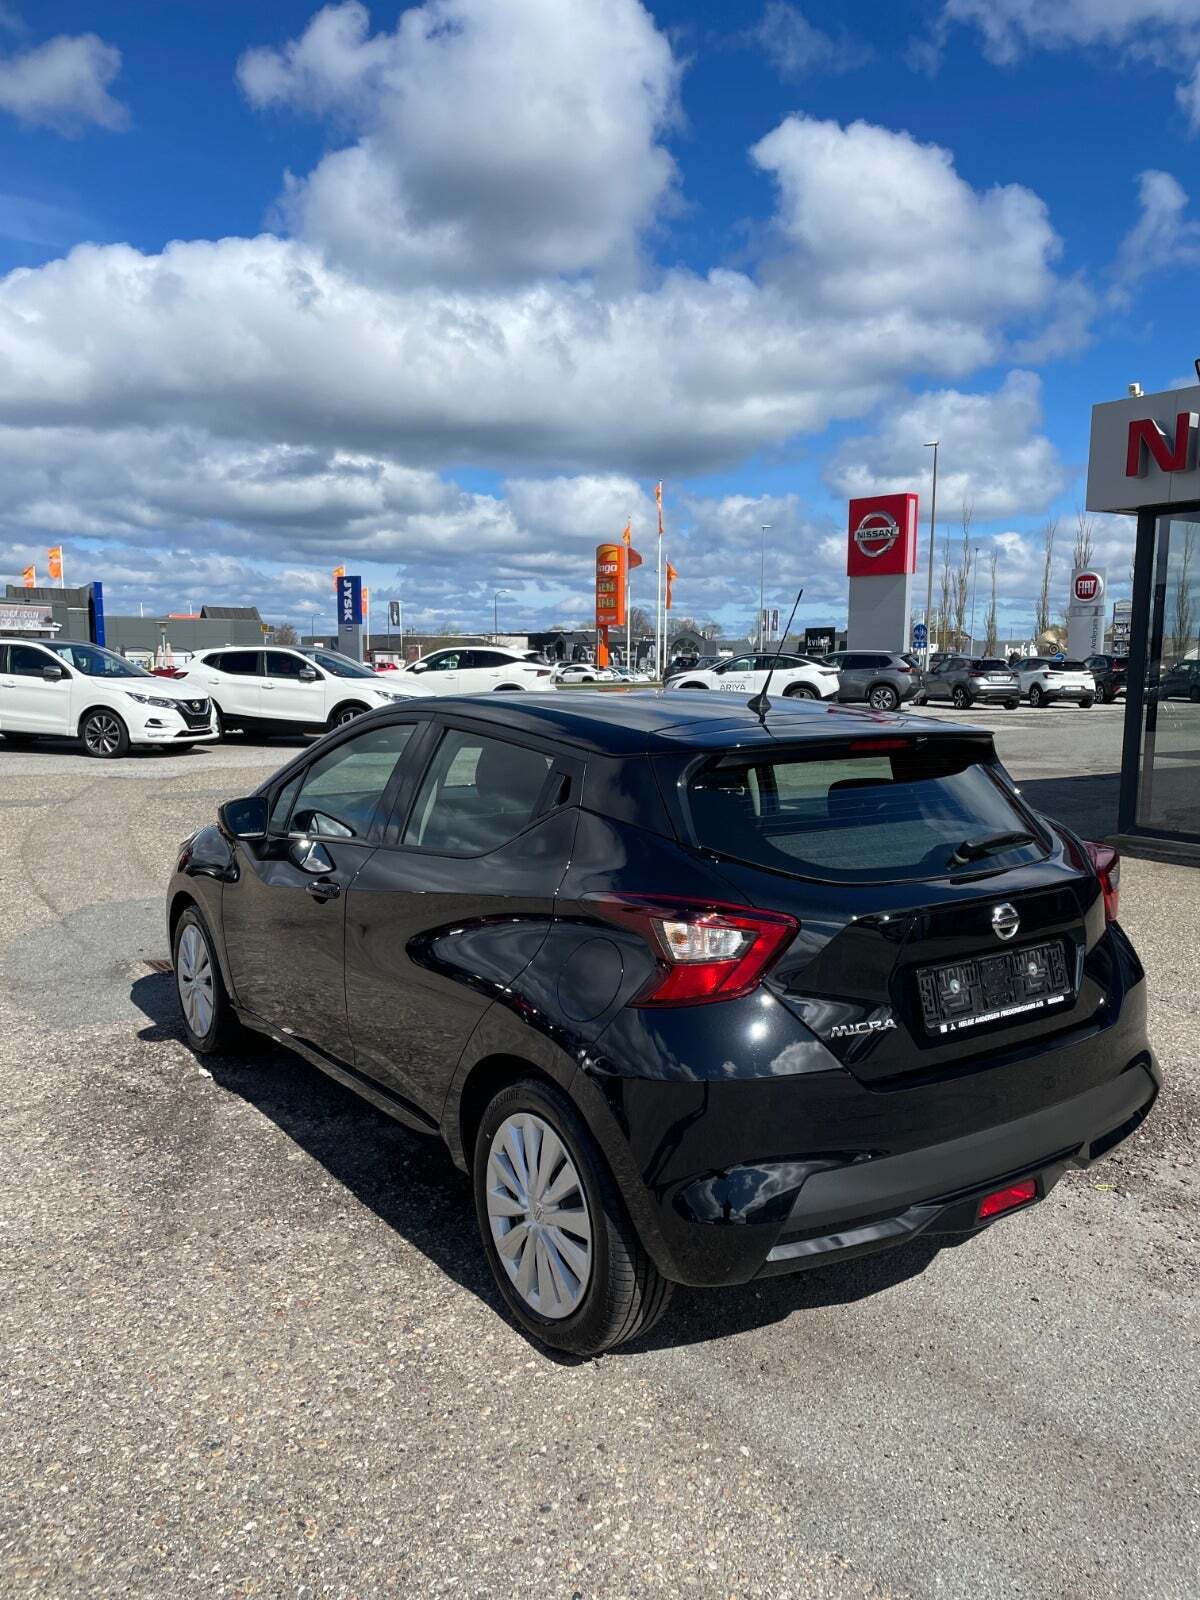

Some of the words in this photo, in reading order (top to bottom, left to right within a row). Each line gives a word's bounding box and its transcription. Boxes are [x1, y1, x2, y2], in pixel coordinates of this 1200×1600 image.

[857, 528, 894, 539] NISSAN
[1077, 580, 1096, 595] FIAT
[343, 579, 353, 621] JYSK
[720, 683, 746, 692] ARIYA
[831, 1018, 898, 1038] MICRA
